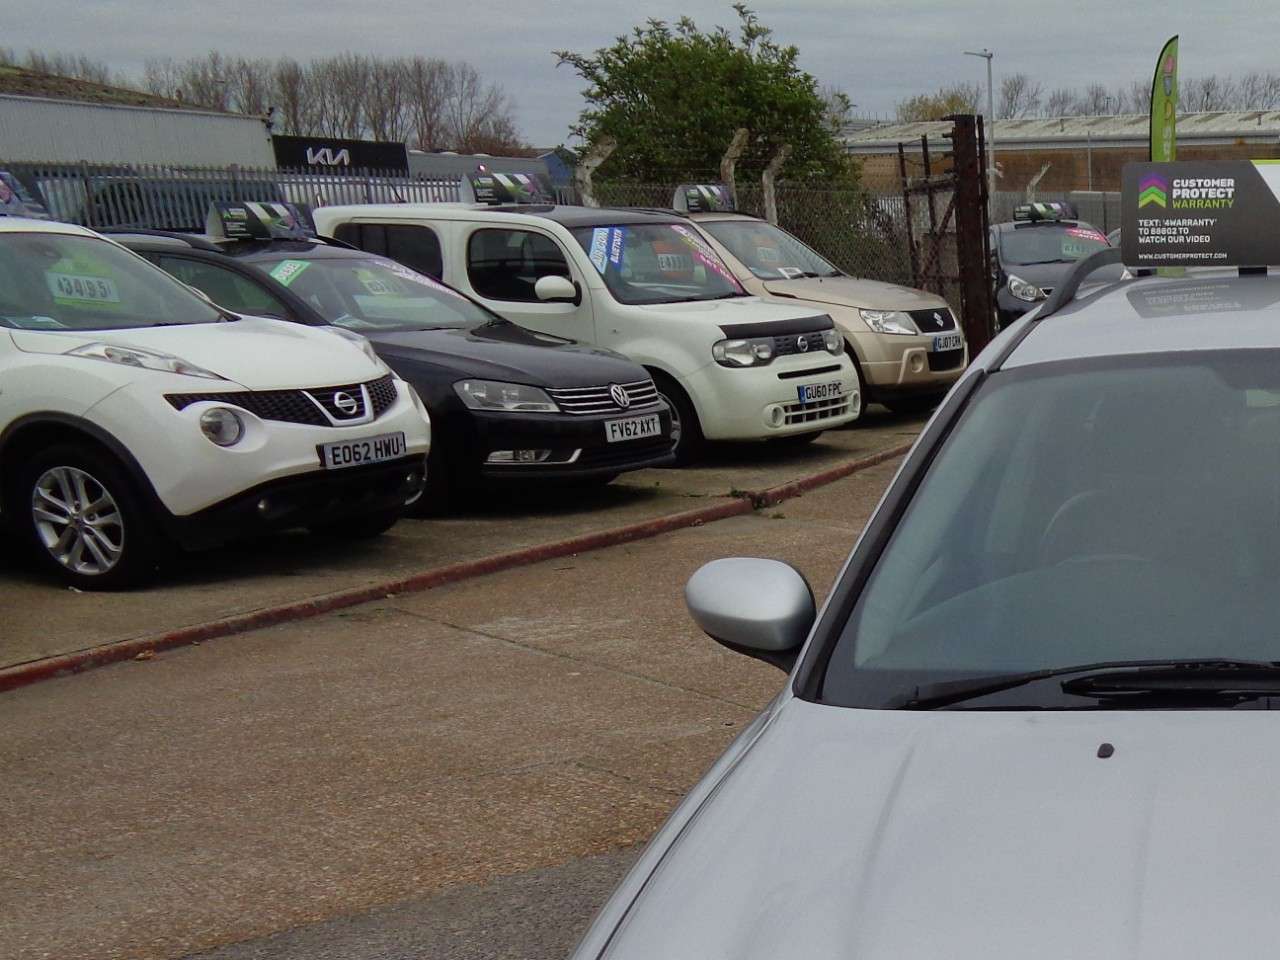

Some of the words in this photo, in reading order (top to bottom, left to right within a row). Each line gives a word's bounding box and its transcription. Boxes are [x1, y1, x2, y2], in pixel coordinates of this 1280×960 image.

[1172, 178, 1235, 188] CUSTOMER
[1172, 188, 1235, 199] PROTECT
[1172, 199, 1235, 209] WARRANTY
[1138, 219, 1162, 227] TEXT:
[1138, 227, 1150, 236] TO
[1178, 227, 1190, 236] TO
[1138, 235, 1167, 244] WATCH
[1167, 235, 1185, 244] OUR
[1185, 235, 1211, 243] VIDEO
[610, 421, 638, 440] FV62
[374, 437, 400, 458] HWU
